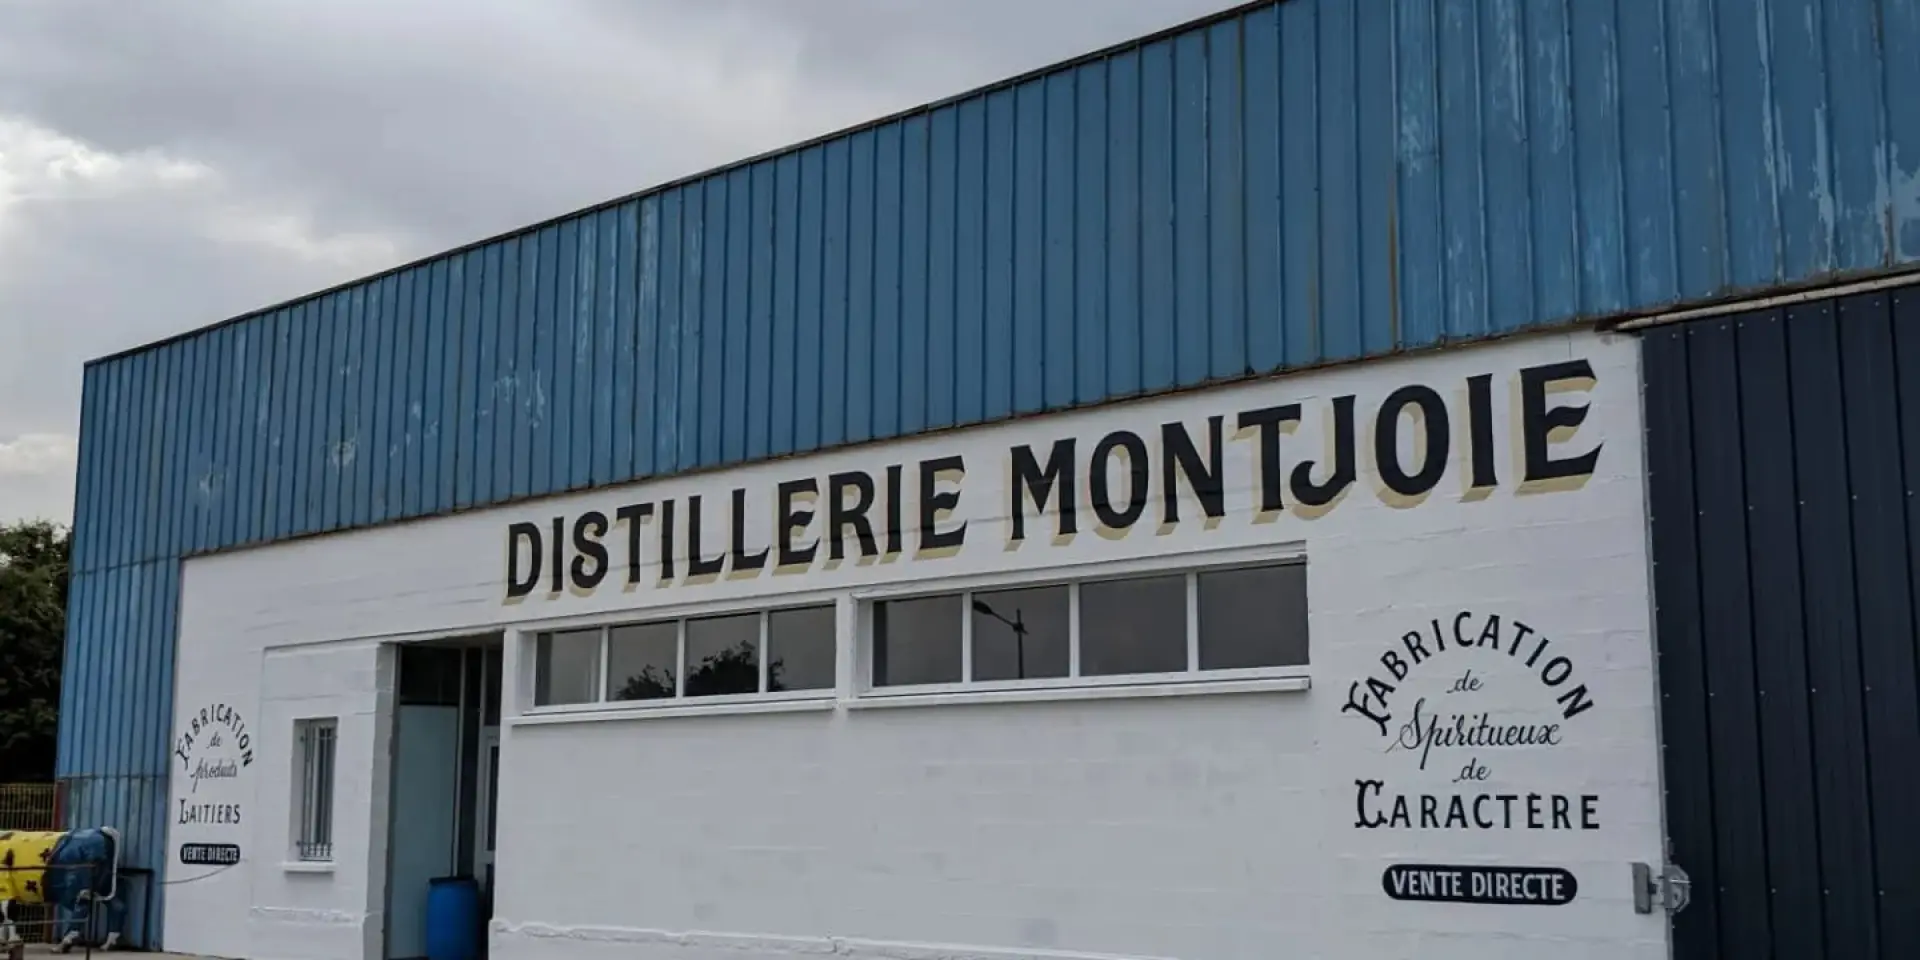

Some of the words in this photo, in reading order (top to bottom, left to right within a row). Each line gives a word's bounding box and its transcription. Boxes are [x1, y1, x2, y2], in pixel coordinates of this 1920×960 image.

[505, 454, 968, 600] DISTILLERIE
[1008, 358, 1605, 543] MONTJOIE
[1341, 611, 1595, 737] FABRICATION
[1446, 669, 1485, 694] de
[175, 703, 254, 771] FABRICATION
[206, 731, 222, 749] de
[1385, 697, 1563, 770] Spiritueux
[1452, 758, 1492, 783] de
[178, 798, 241, 825] LAITIERS
[1354, 779, 1601, 830] CARACTÈRE
[183, 847, 206, 861] VENTE
[207, 847, 238, 862] DIRECTE
[1391, 869, 1464, 897] VENTE
[1471, 872, 1566, 901] DIRECTE
